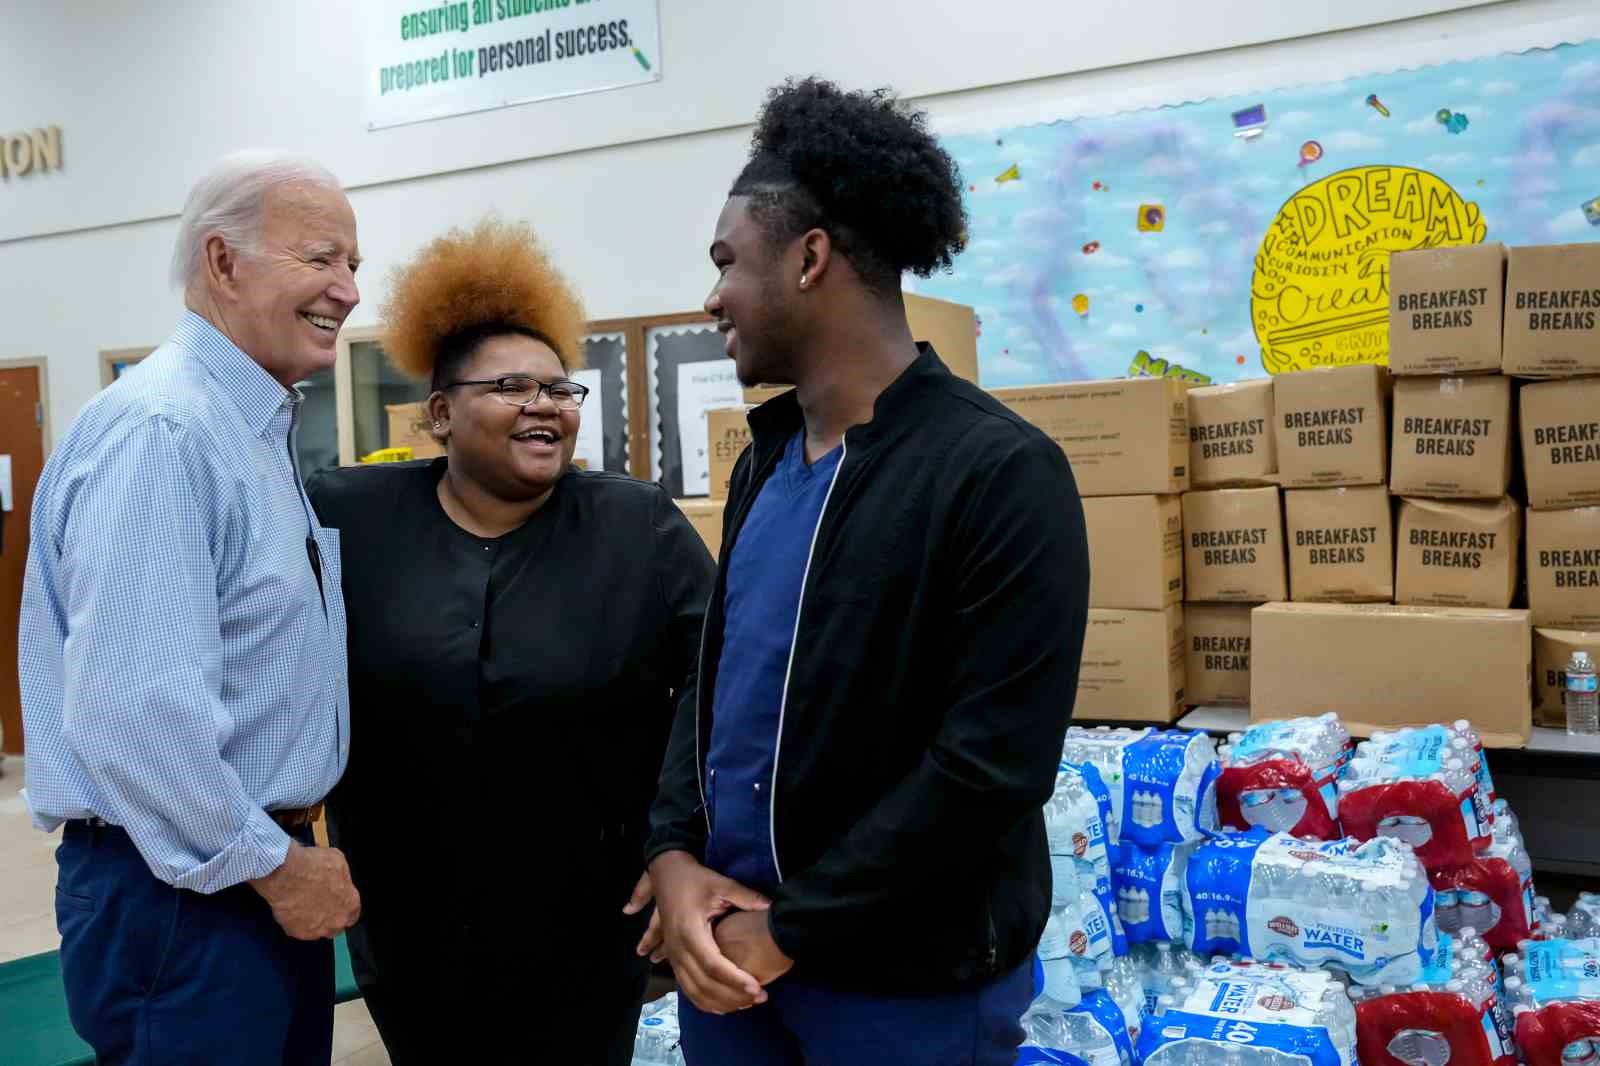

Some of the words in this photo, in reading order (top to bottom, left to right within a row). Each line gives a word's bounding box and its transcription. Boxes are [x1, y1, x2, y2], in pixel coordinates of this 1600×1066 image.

[401, 1, 469, 40] ensuring
[380, 49, 449, 95] prepared
[452, 47, 476, 80] for
[479, 28, 551, 78] personal
[555, 18, 632, 59] success.
[1293, 168, 1463, 247] DREAM
[1276, 227, 1413, 261] COMMUNICATION
[1268, 256, 1349, 277] CURIOSITY
[1278, 264, 1389, 323] Creat
[1398, 288, 1487, 311] BREAKFAST
[1515, 289, 1600, 309] BREAKFAS
[1412, 310, 1473, 330] BREAKS
[1529, 311, 1595, 330] BREAKS
[1284, 408, 1364, 429] BREAKFAST
[1404, 417, 1491, 436] BREAKFAST
[1190, 419, 1264, 442] BREAKFAST
[1298, 428, 1353, 447] BREAKS
[1535, 422, 1600, 445] BREAKF
[1203, 440, 1254, 459] BREAKS
[1415, 438, 1475, 456] BREAKS
[1191, 529, 1267, 548] BREAKFAST
[1295, 527, 1376, 546] BREAKFAST
[1409, 529, 1496, 549] BREAKFAST
[1204, 548, 1256, 566] BREAKS
[1309, 547, 1365, 564] BREAKS
[1422, 550, 1481, 568] BREAKS
[1540, 550, 1600, 568] BREAKF
[1555, 570, 1600, 587] BREA
[1193, 636, 1250, 652] BREAKFA
[1205, 655, 1249, 671] BREAK
[1304, 927, 1364, 951] WATER
[1222, 983, 1249, 1014] WATER
[1225, 1021, 1258, 1043] 40
